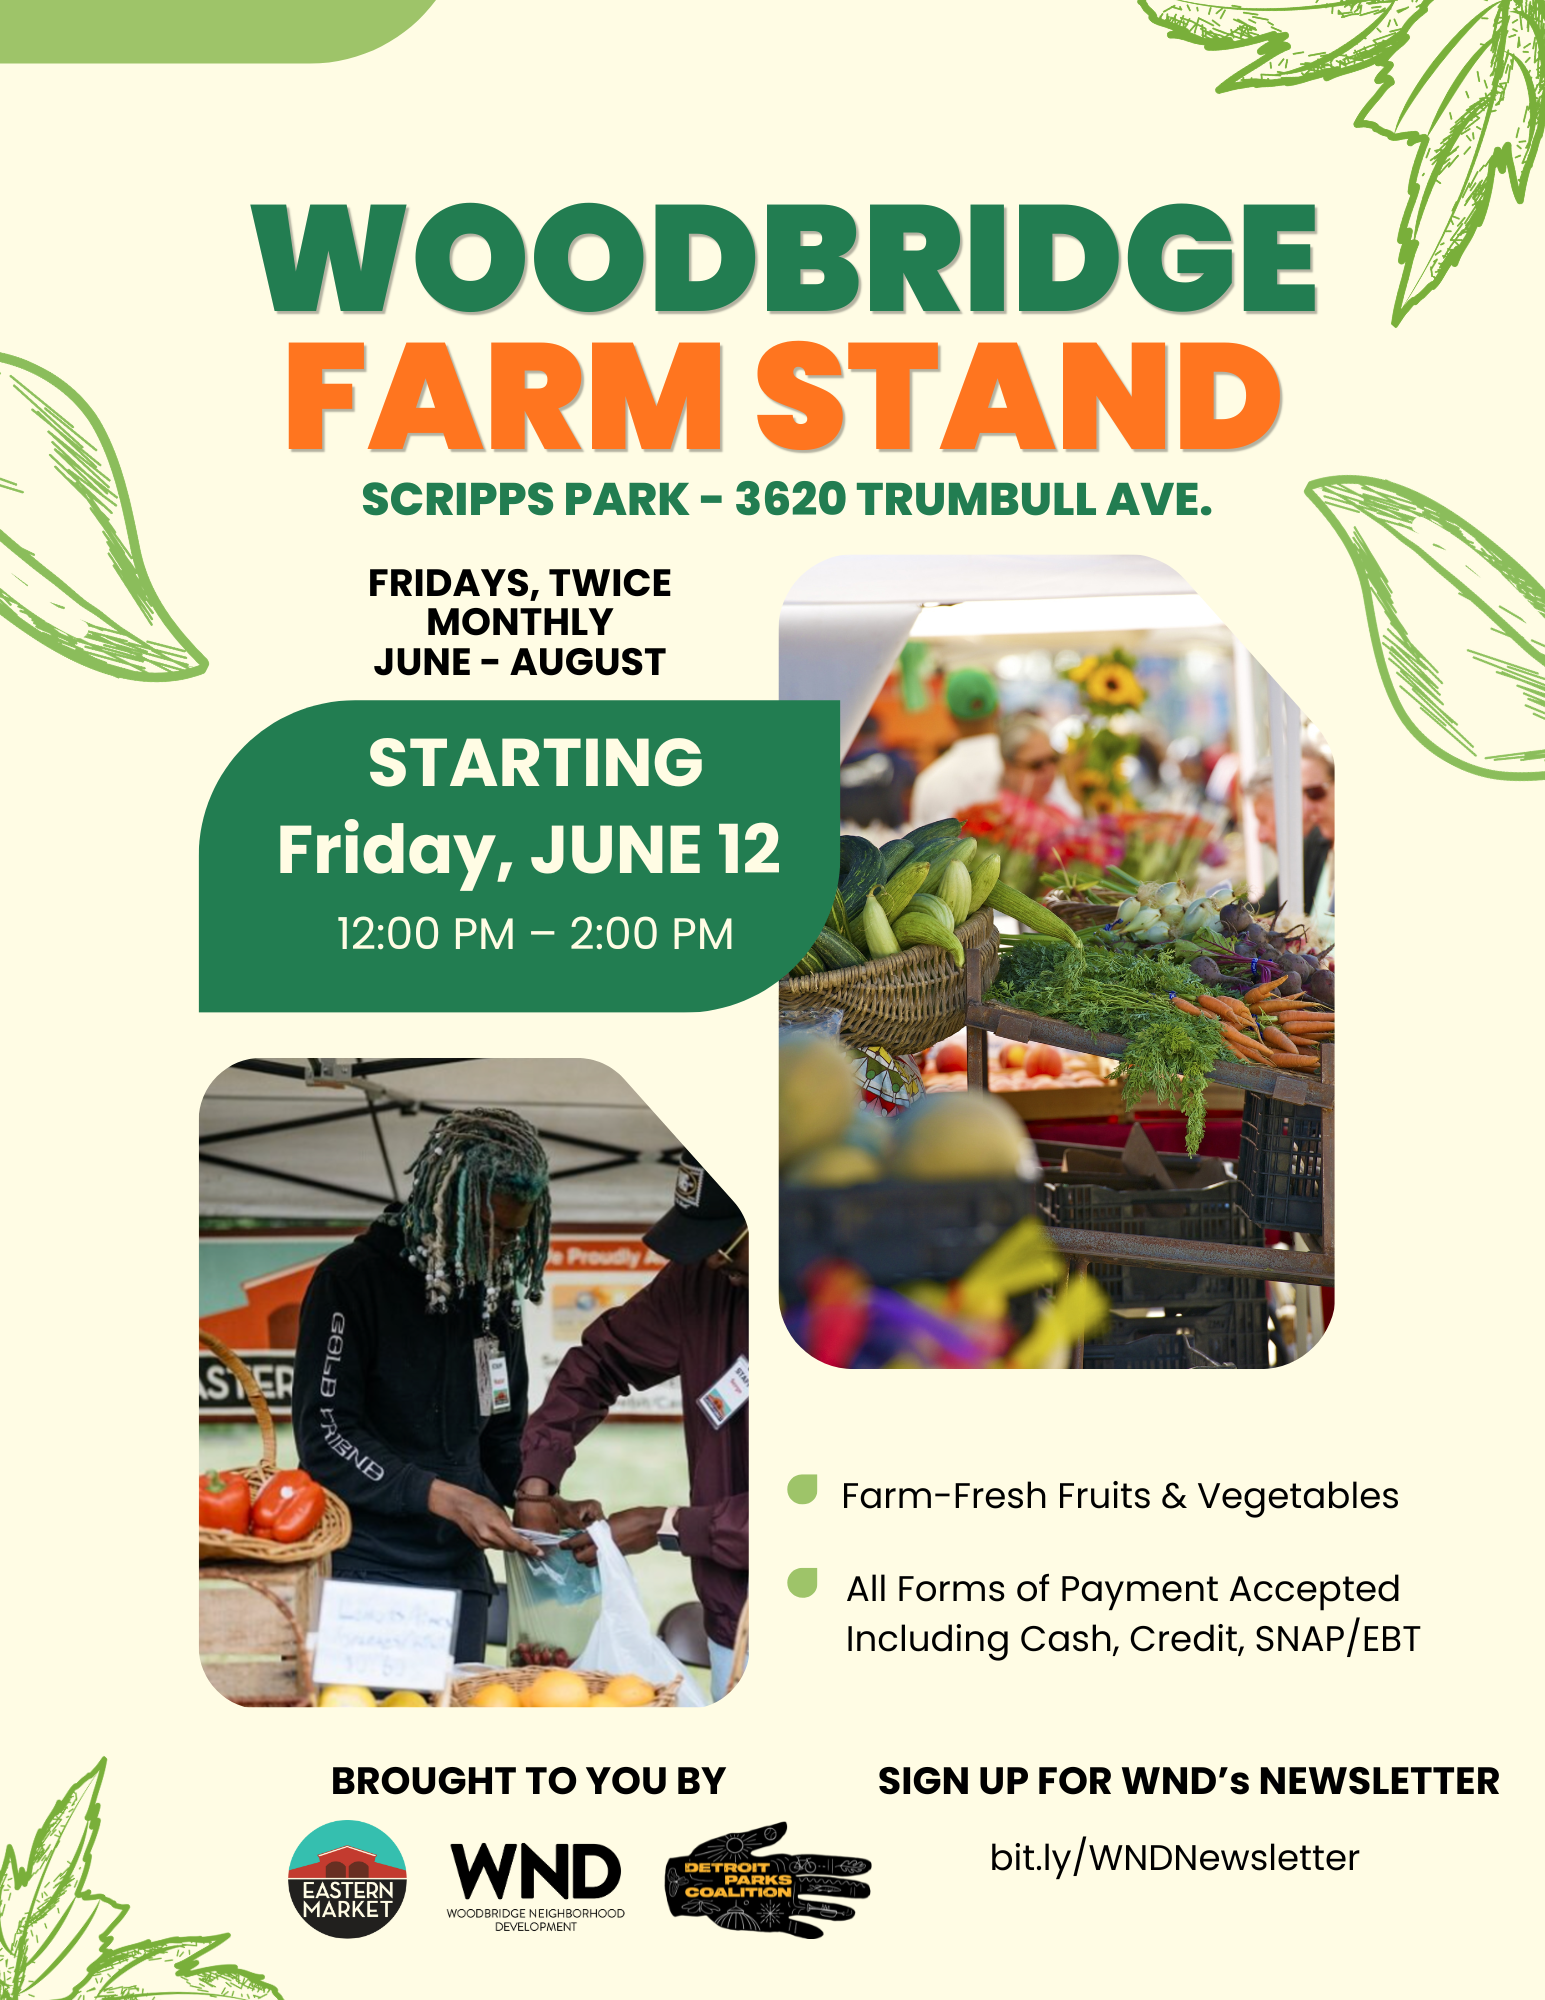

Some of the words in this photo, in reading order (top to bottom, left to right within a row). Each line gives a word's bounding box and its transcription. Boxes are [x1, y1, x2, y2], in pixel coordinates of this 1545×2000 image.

[250, 203, 1317, 315] WOODBRIDGE
[286, 341, 722, 452] FARM
[757, 341, 1282, 453] STAND
[362, 482, 554, 516] SCRIPPS
[566, 482, 690, 516] PARK
[736, 481, 846, 516] 3620
[856, 482, 1096, 516] TRUMBULL
[1106, 482, 1213, 516] AVE.
[369, 568, 539, 601] FRIDAYS,
[549, 569, 671, 597] TWICE
[427, 607, 614, 636] MONTHLY
[374, 648, 471, 676] JUNE
[510, 647, 667, 676] AUGUST
[369, 737, 703, 787] STARTING
[279, 818, 513, 892] Friday,
[531, 824, 701, 874] JUNE
[718, 822, 780, 874] 12
[338, 916, 439, 950] 12:00
[455, 918, 514, 950] PM
[571, 916, 658, 950] 2:00
[673, 918, 733, 950] PM
[567, 1247, 641, 1270] Proudly
[843, 1481, 1047, 1510] Farm-Fresh
[1059, 1481, 1151, 1510] Fruits
[1161, 1482, 1188, 1510] &
[1198, 1481, 1399, 1518] Vegetables
[847, 1574, 886, 1602] All
[898, 1575, 1005, 1602] Forms
[1016, 1573, 1051, 1602] of
[1061, 1575, 1219, 1611] Payment
[1229, 1574, 1400, 1611] Accepted
[847, 1624, 1008, 1661] Including
[1021, 1624, 1119, 1657] Cash,
[1130, 1624, 1245, 1657] Credit,
[1256, 1617, 1421, 1658] SNAP/EBT
[333, 1766, 516, 1796] BROUGHT
[526, 1766, 578, 1796] TO
[586, 1766, 667, 1796] YOU
[677, 1766, 728, 1795] BY
[878, 1766, 969, 1796] SIGN
[979, 1767, 1029, 1796] UP
[1038, 1766, 1112, 1796] FOR
[1121, 1766, 1250, 1796] WND’s
[1260, 1766, 1500, 1796] NEWSLETTER
[450, 1843, 621, 1900] WND
[684, 1862, 771, 1873] DETROIT
[991, 1836, 1361, 1880] bit.ly/WNDNewsletter
[303, 1881, 392, 1899] EASTERN
[684, 1887, 792, 1898] COALITION
[724, 1875, 793, 1886] PARKS
[303, 1900, 394, 1918] MARKET
[446, 1908, 526, 1919] WOODBRIDGE
[529, 1908, 626, 1919] NEIGHBORHOOD
[495, 1921, 578, 1932] DEVELOPMENT
